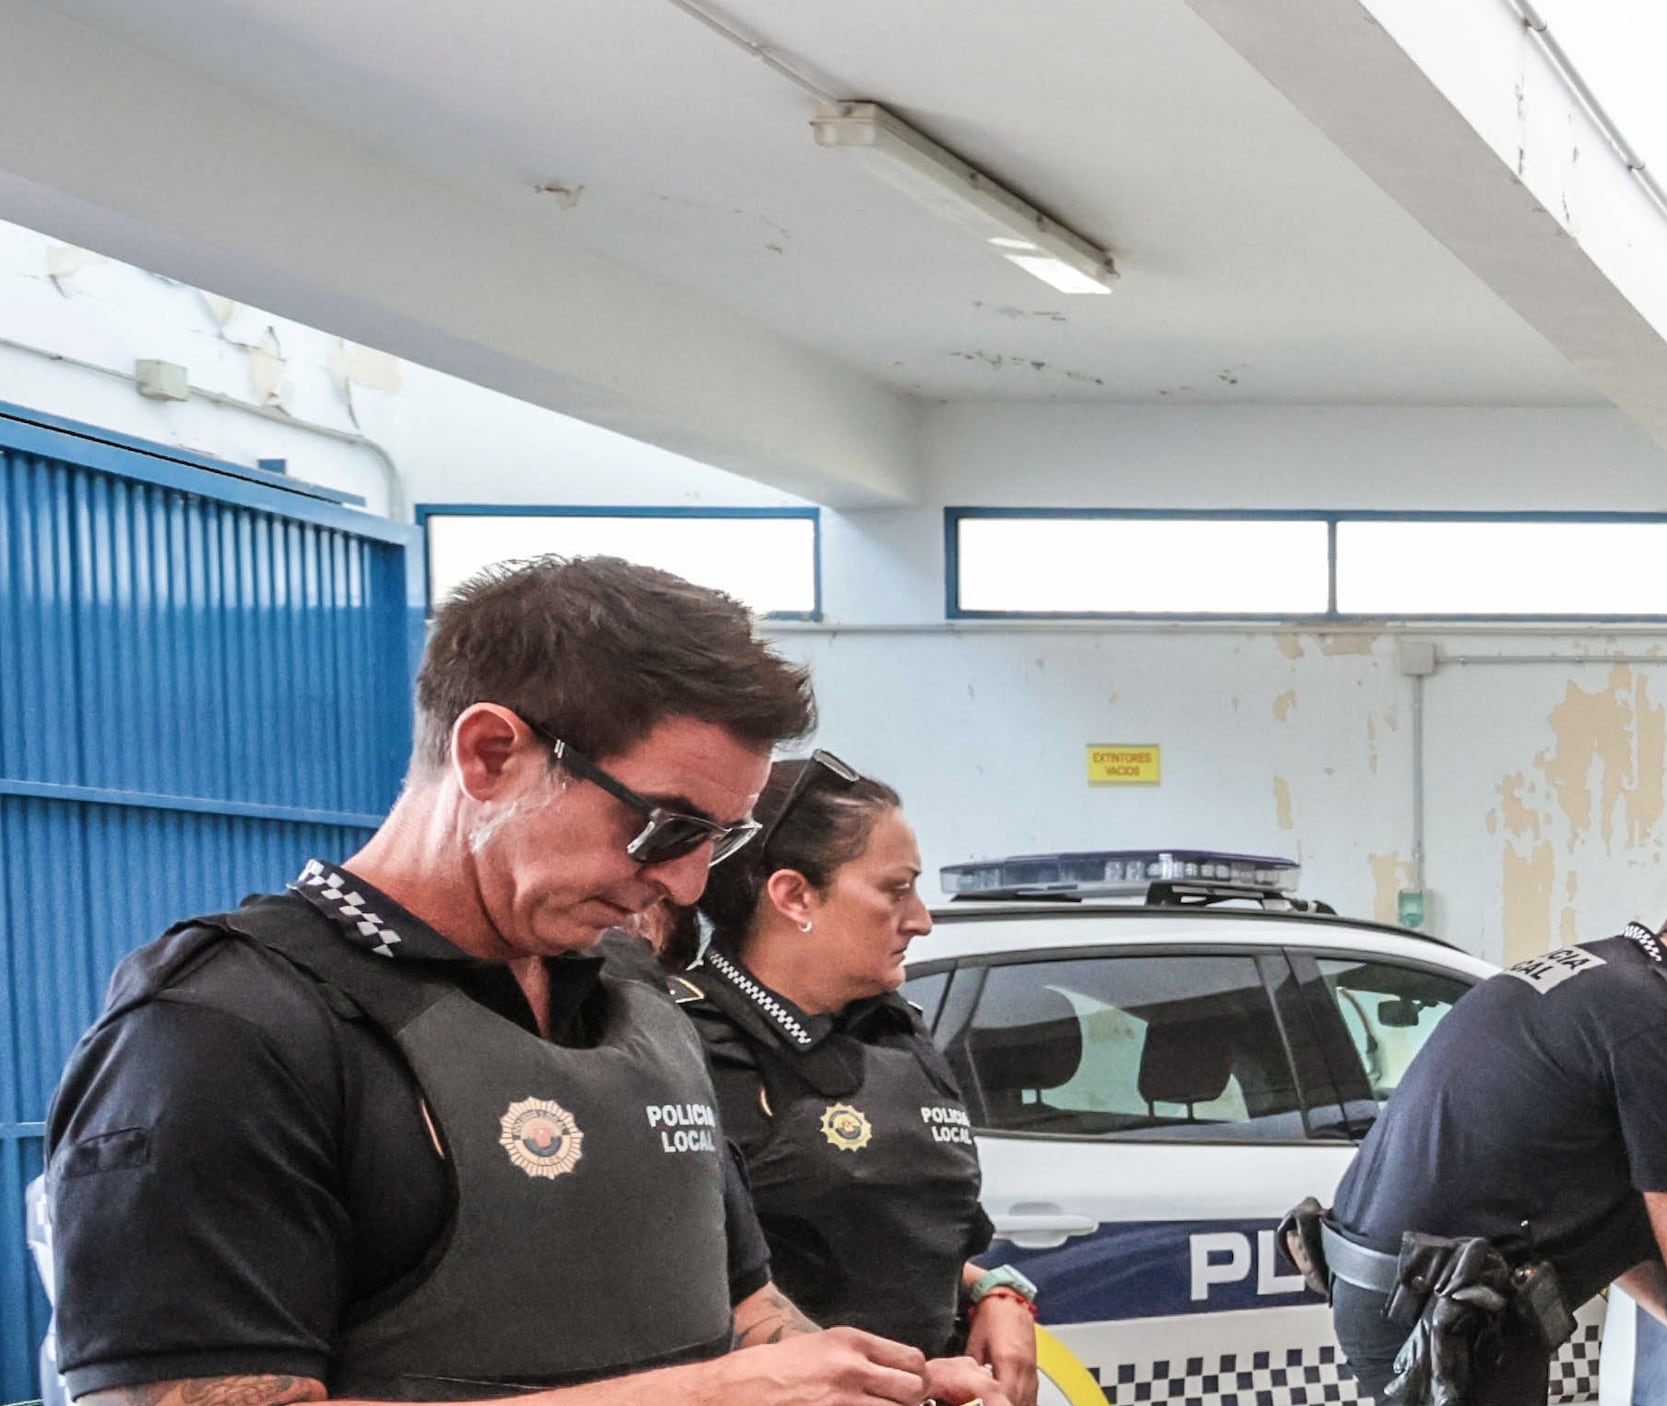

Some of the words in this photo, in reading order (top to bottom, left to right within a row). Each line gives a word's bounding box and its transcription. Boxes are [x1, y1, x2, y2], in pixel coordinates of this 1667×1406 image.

[661, 1130, 716, 1153] LOCAL
[931, 1126, 972, 1145] LOCAL
[1189, 1229, 1306, 1301] PL
